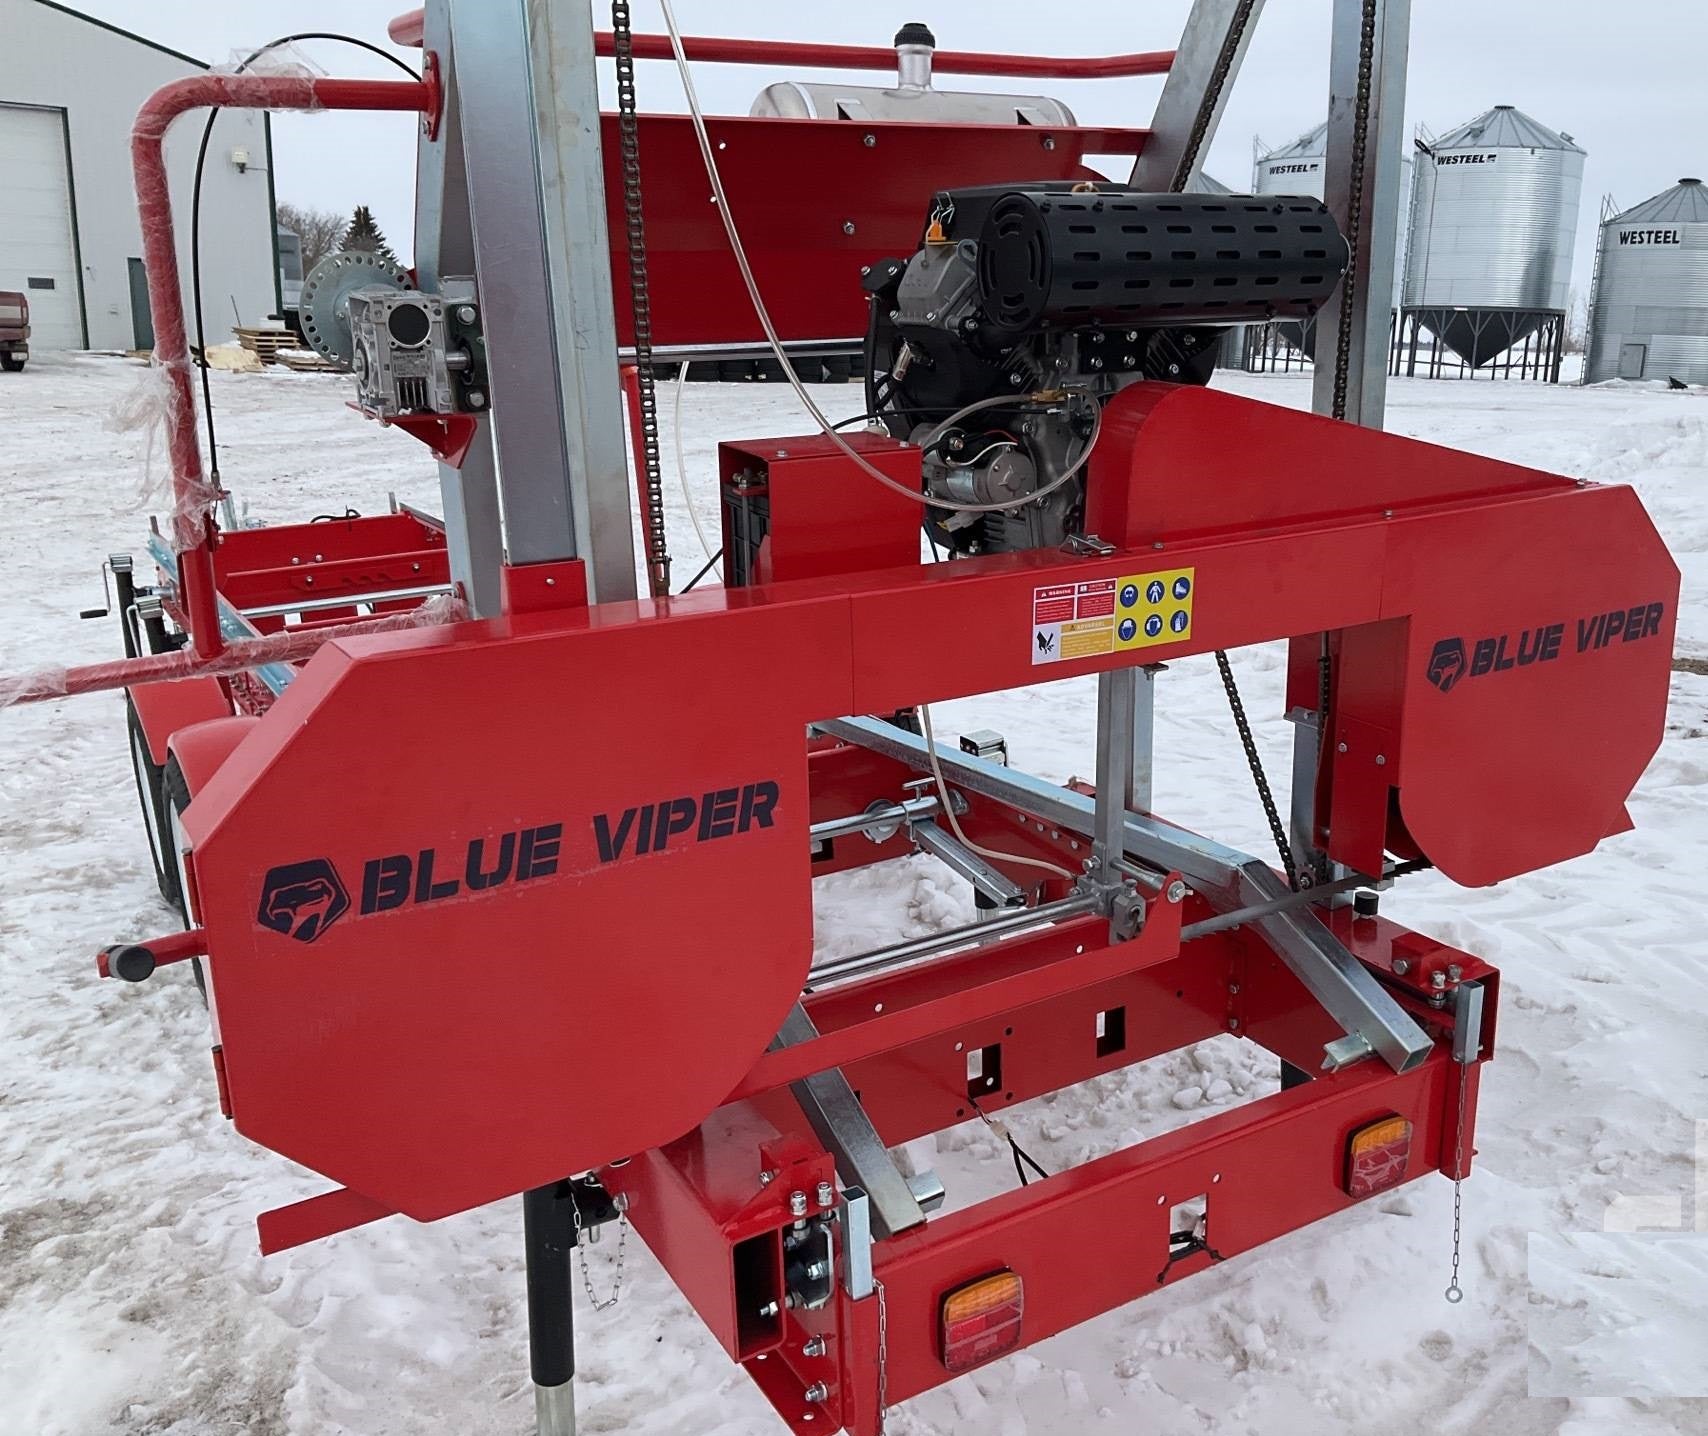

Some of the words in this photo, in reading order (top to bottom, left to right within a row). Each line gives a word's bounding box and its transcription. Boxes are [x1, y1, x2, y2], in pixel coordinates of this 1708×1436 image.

[1437, 154, 1485, 166] WESTEEL
[1269, 164, 1308, 175] WESTEEL
[1619, 230, 1680, 245] WESTEEL
[1469, 623, 1565, 677] BLUE
[1576, 602, 1664, 653] VIPER
[360, 823, 563, 916] BLUE
[592, 780, 780, 863] VIPER
